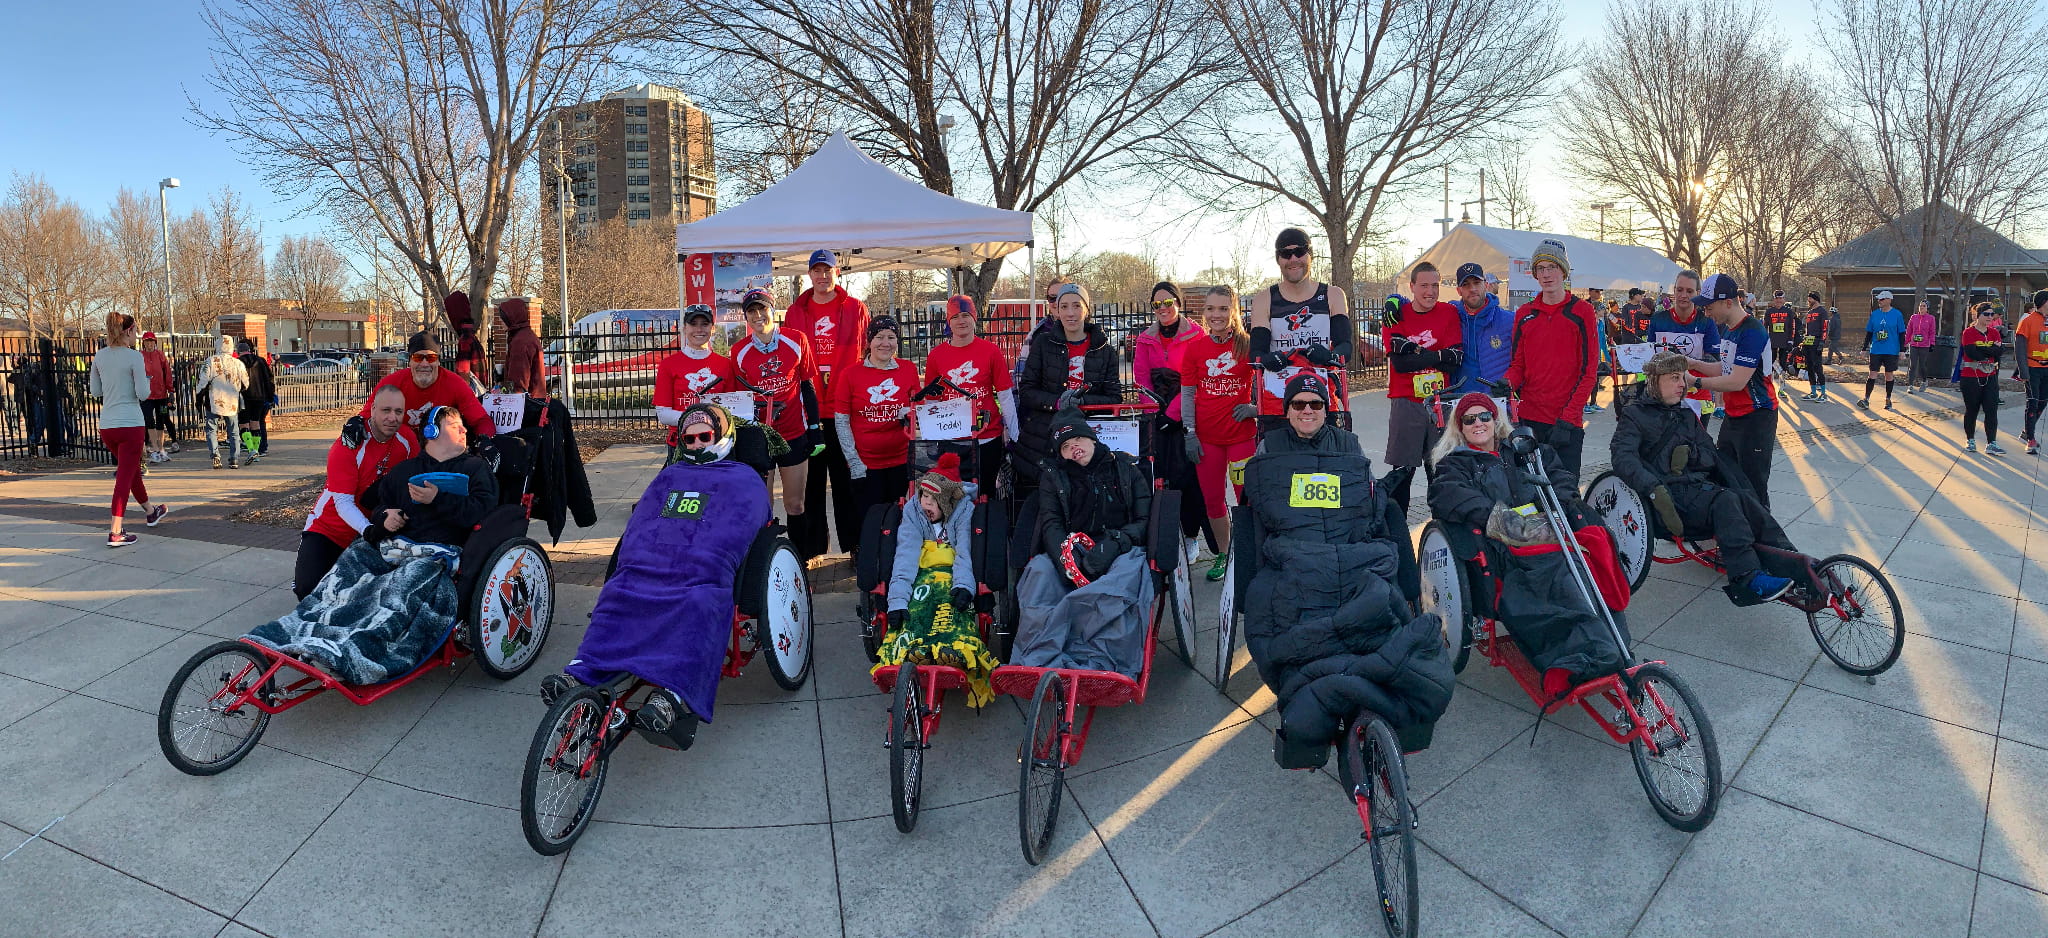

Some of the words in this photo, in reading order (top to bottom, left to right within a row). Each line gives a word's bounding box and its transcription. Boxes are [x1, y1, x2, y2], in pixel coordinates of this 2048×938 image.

[1273, 336, 1330, 349] TRIUMPH
[1201, 381, 1247, 392] TRIUMPH
[936, 420, 962, 432] Teddy
[1303, 483, 1340, 502] 863
[677, 498, 701, 514] 86
